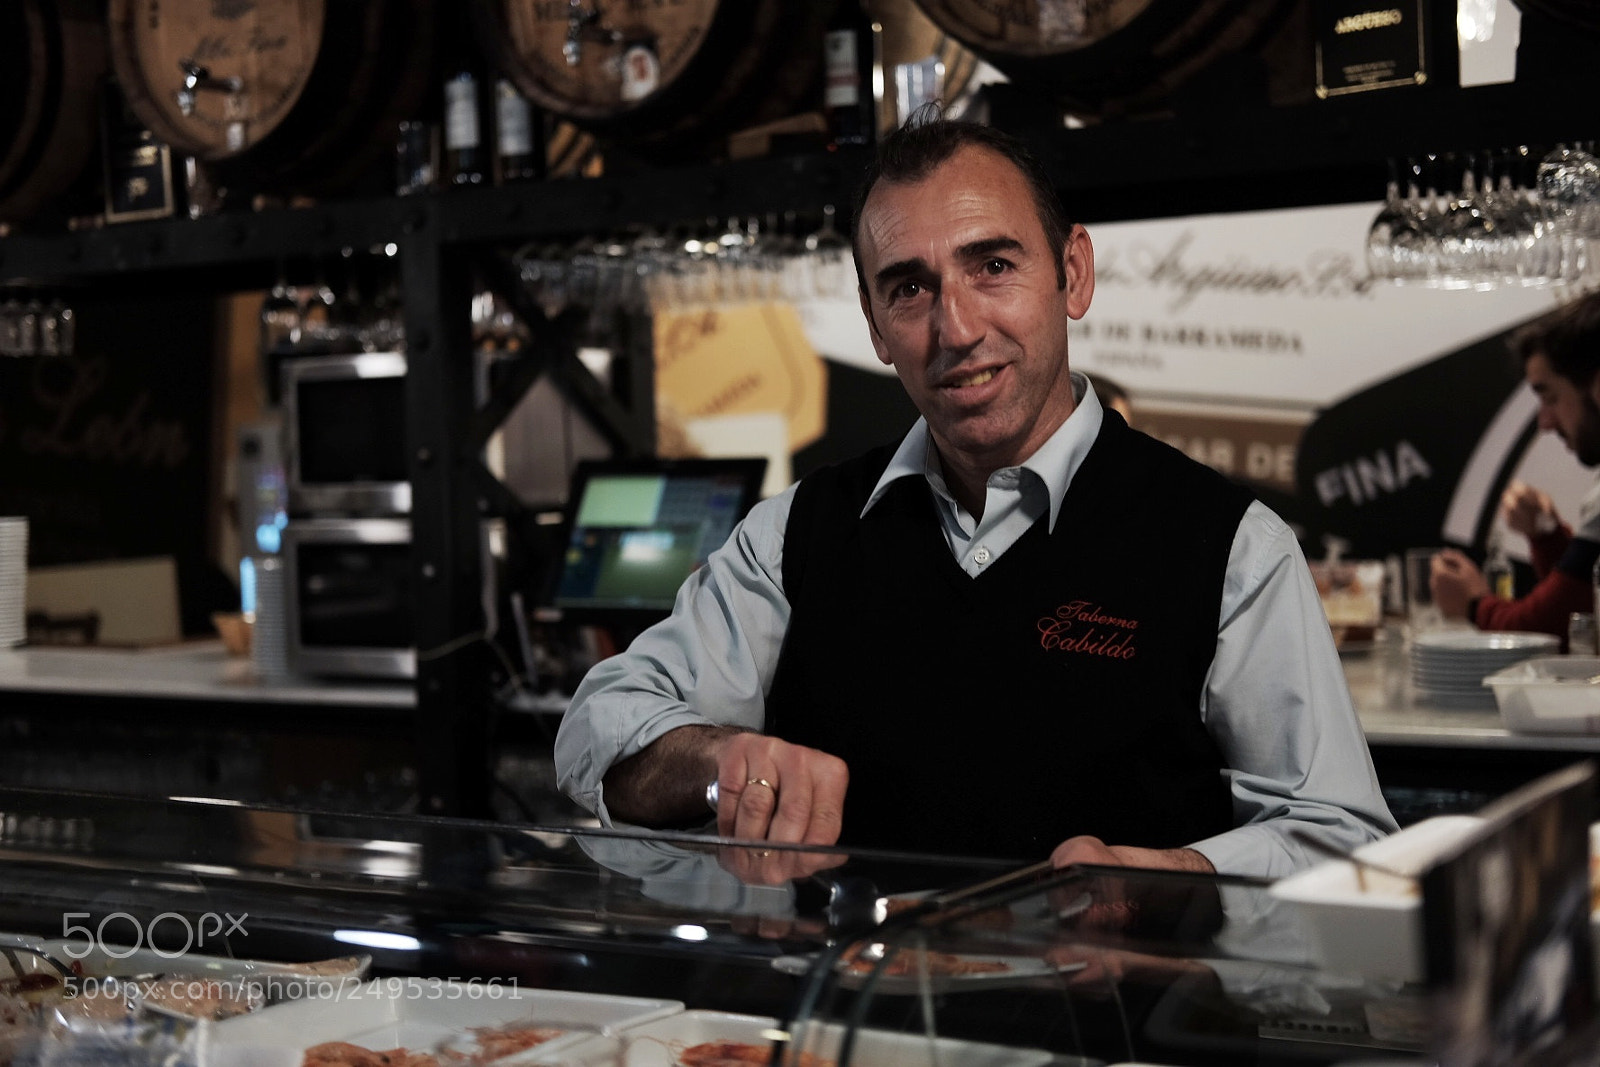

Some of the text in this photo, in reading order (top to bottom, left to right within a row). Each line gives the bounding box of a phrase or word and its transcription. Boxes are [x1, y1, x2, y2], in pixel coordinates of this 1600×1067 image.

[1313, 438, 1433, 508] FINA
[1056, 599, 1139, 630] Taberna
[1037, 616, 1136, 660] Cabildo
